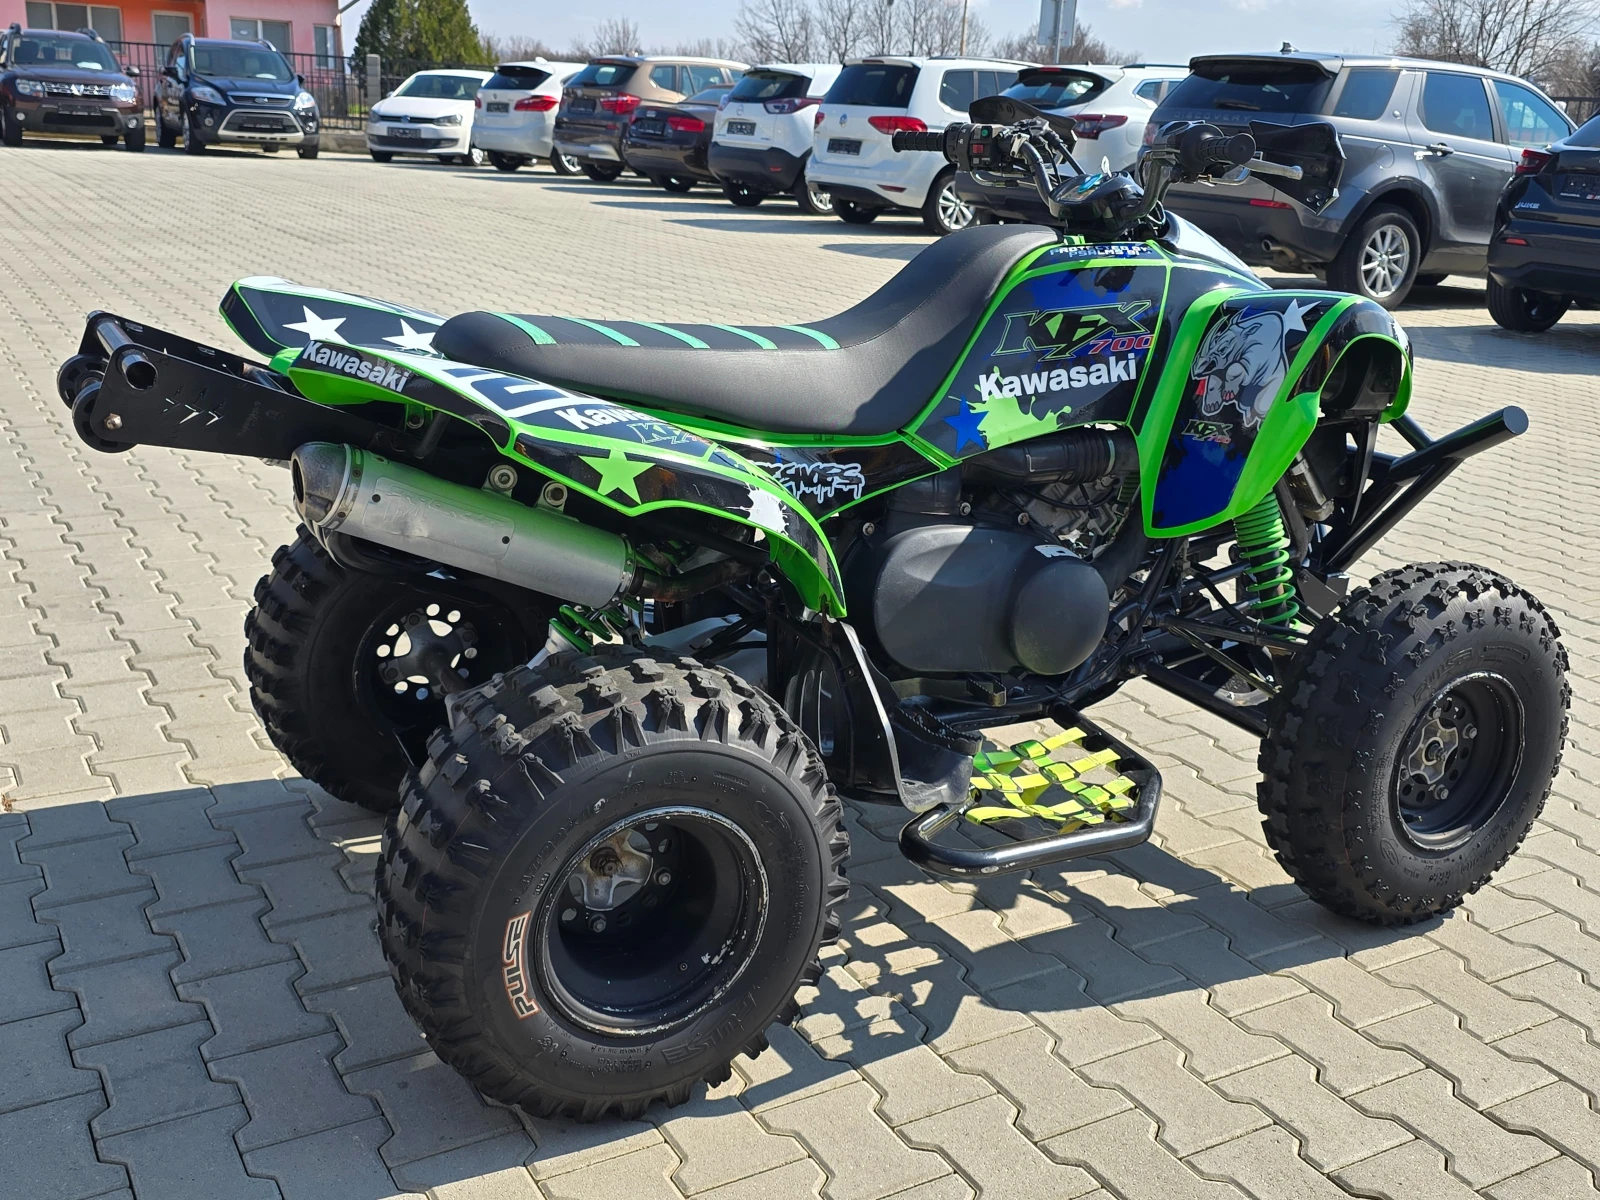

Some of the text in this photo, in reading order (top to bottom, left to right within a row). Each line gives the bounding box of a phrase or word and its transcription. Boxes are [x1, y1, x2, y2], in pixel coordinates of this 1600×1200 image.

[1173, 111, 1252, 121] DISCOVERY
[1050, 245, 1127, 255] PROTECTED
[1069, 248, 1124, 257] PSALMS
[990, 300, 1155, 362] KFX 700
[301, 340, 412, 393] Kawasaki
[979, 352, 1137, 401] Kawasaki
[1181, 419, 1233, 441] KFX
[503, 910, 541, 1019] PULSE
